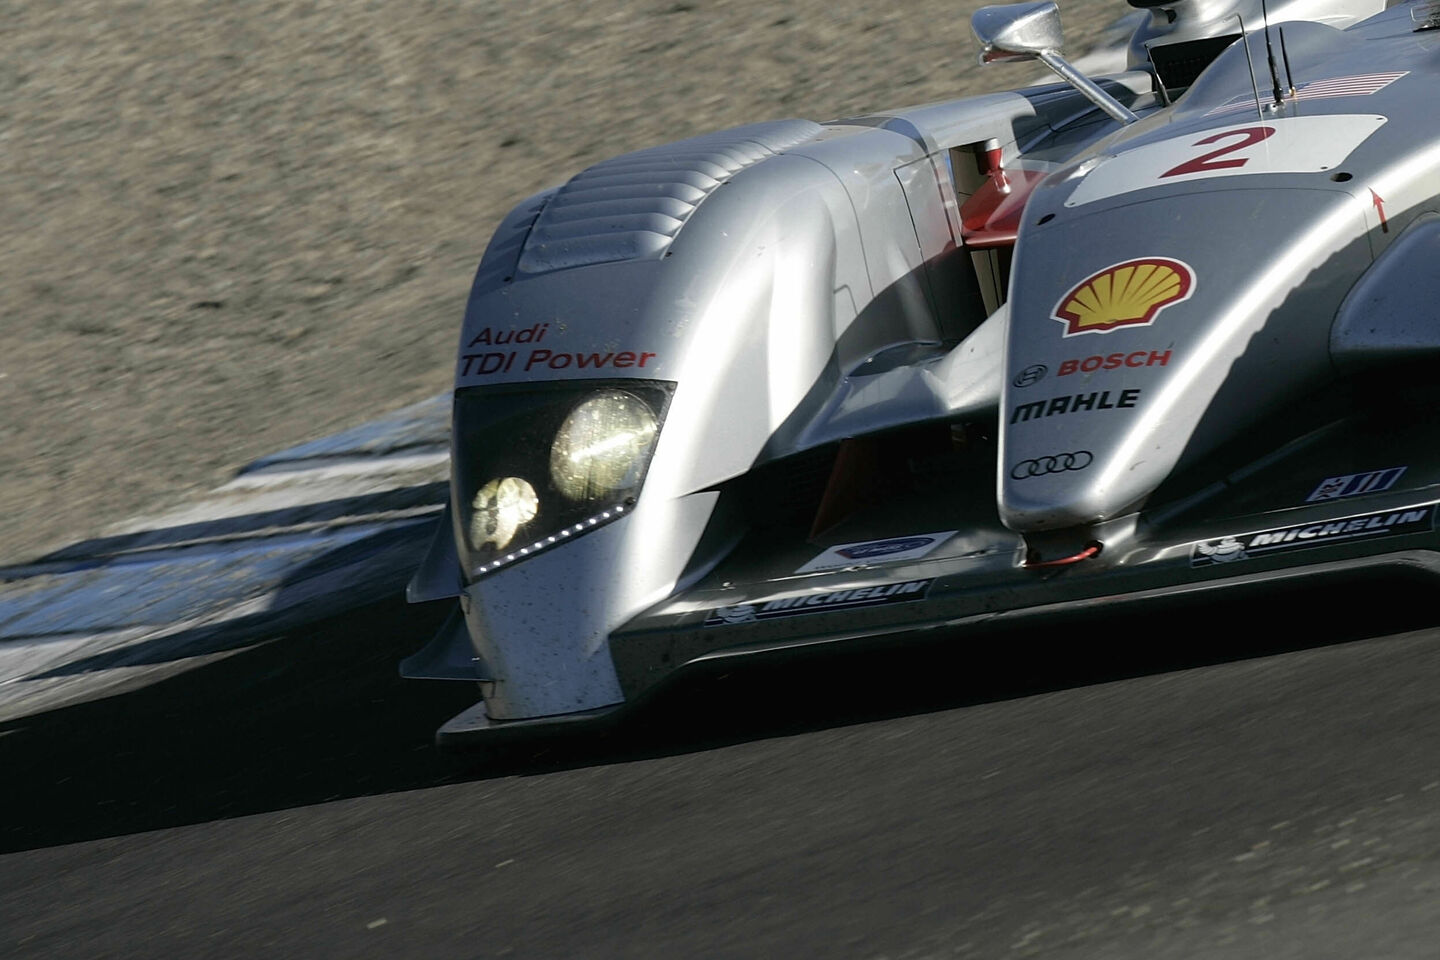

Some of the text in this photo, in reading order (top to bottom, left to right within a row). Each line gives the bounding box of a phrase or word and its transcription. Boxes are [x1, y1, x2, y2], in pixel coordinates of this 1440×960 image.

[1158, 126, 1276, 179] 2
[469, 323, 549, 348] Audi
[461, 349, 657, 378] TDI Power
[1056, 350, 1172, 377] BOSCH
[1010, 388, 1141, 425] MAHLE
[1249, 509, 1428, 547] MICHELIN
[760, 579, 930, 611] MICHELIN
